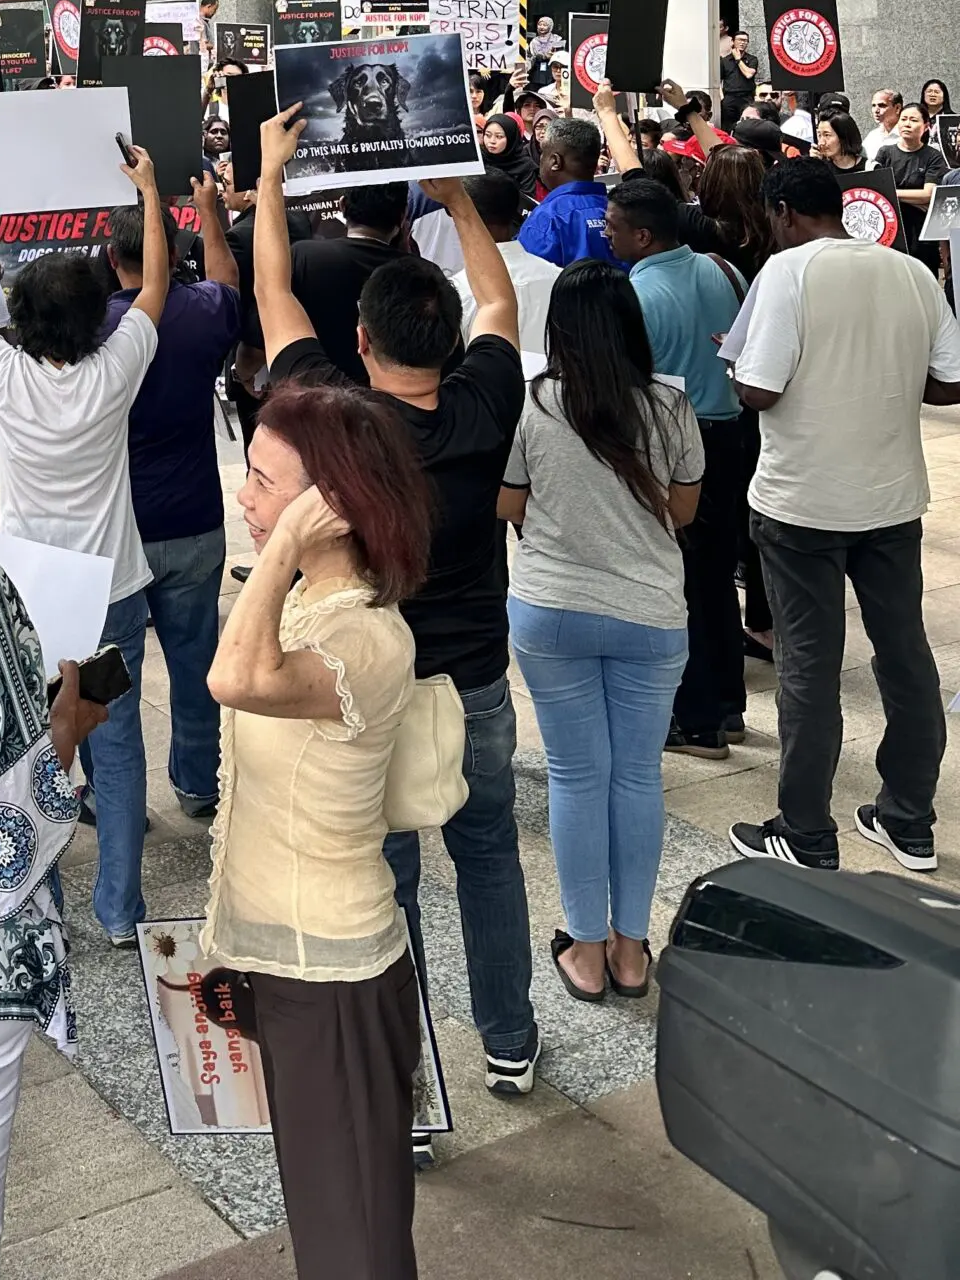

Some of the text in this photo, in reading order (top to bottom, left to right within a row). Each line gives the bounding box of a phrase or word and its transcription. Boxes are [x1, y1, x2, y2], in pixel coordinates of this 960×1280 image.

[85, 7, 141, 17] JUSTICE FOR KOPI
[279, 12, 305, 20] JUSTICE
[365, 14, 391, 22] JUSTICE
[393, 14, 407, 22] FOR
[773, 10, 835, 45] JUSTICE FOR KOPI
[153, 39, 171, 49] FOR
[329, 41, 409, 60] JUSTICE FOR KOPI
[575, 36, 600, 67] JUSTICE
[309, 144, 330, 157] THIS
[330, 142, 351, 155] HATE
[351, 142, 359, 154] &
[360, 139, 404, 153] BRUTALITY
[404, 135, 445, 149] TOWARDS
[446, 133, 471, 145] DOGS
[302, 201, 335, 212] HAIWAN
[321, 209, 341, 221] SAF
[854, 191, 896, 223] FOR KOPI
[186, 972, 220, 1085] Saya anjing
[214, 982, 248, 1074] yang baik
